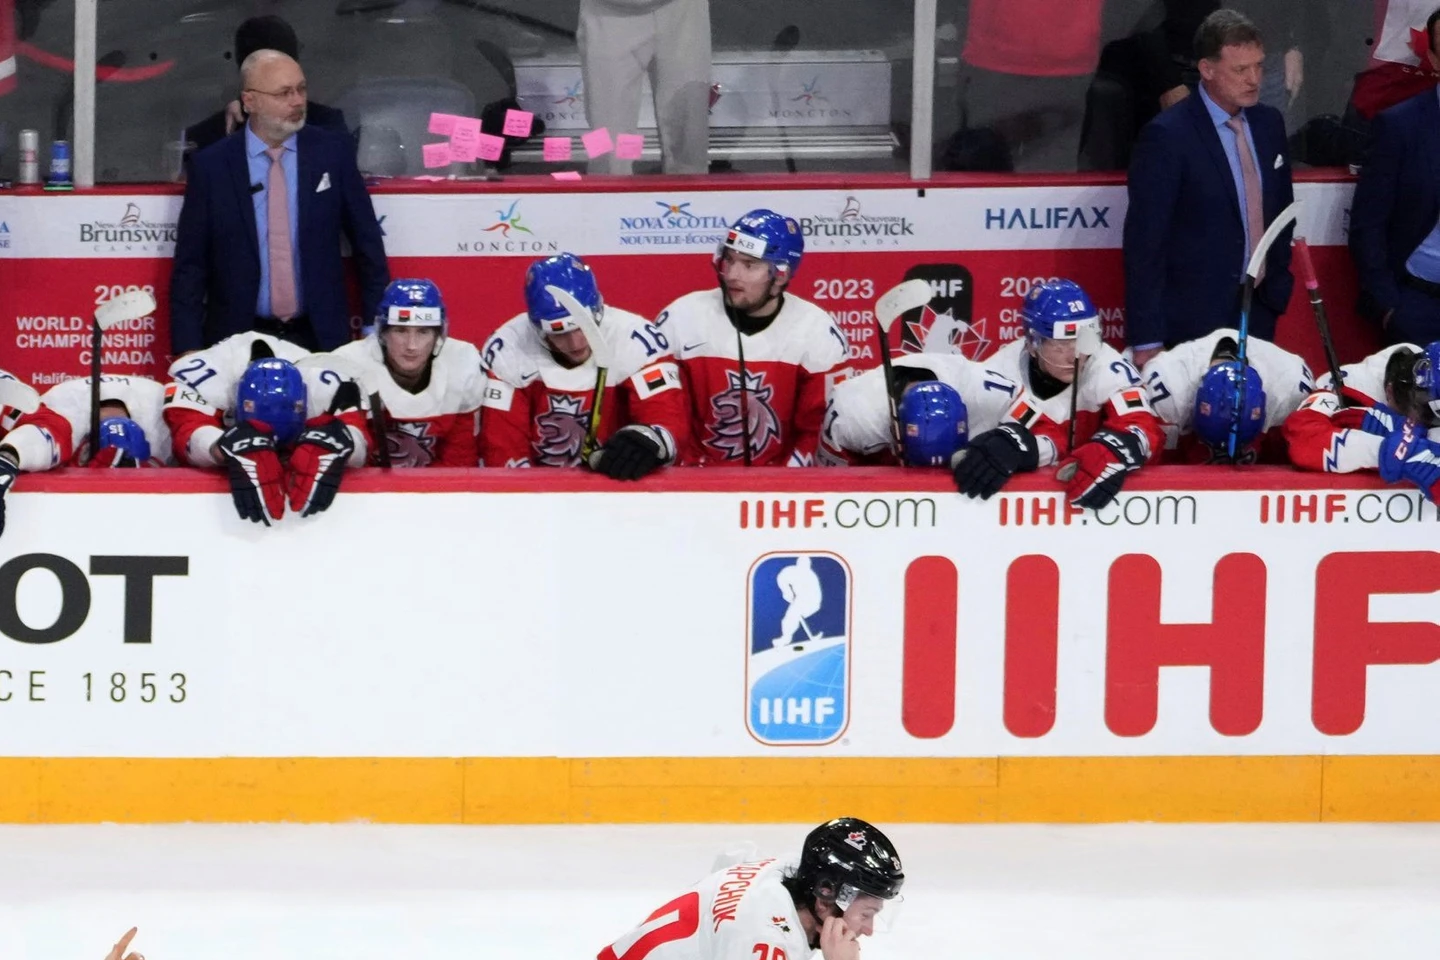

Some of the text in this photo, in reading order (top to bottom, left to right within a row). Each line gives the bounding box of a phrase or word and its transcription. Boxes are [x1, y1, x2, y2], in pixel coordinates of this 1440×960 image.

[620, 217, 662, 230] NOVA
[667, 215, 728, 230] SCOTIA
[800, 217, 914, 237] Brunswick
[985, 206, 1110, 230] HALIFAX
[80, 223, 178, 243] Brunswic
[456, 240, 559, 253] MONCTON
[737, 238, 756, 250] KB
[814, 279, 875, 300] 2023
[1068, 300, 1086, 313] 20
[16, 316, 84, 331] WORLD
[414, 313, 433, 322] KB
[175, 358, 218, 391] 21
[739, 495, 938, 530] IIHF.com
[901, 551, 1440, 739] IIHF
[81, 671, 189, 704] 1853
[759, 696, 837, 725] IIHF
